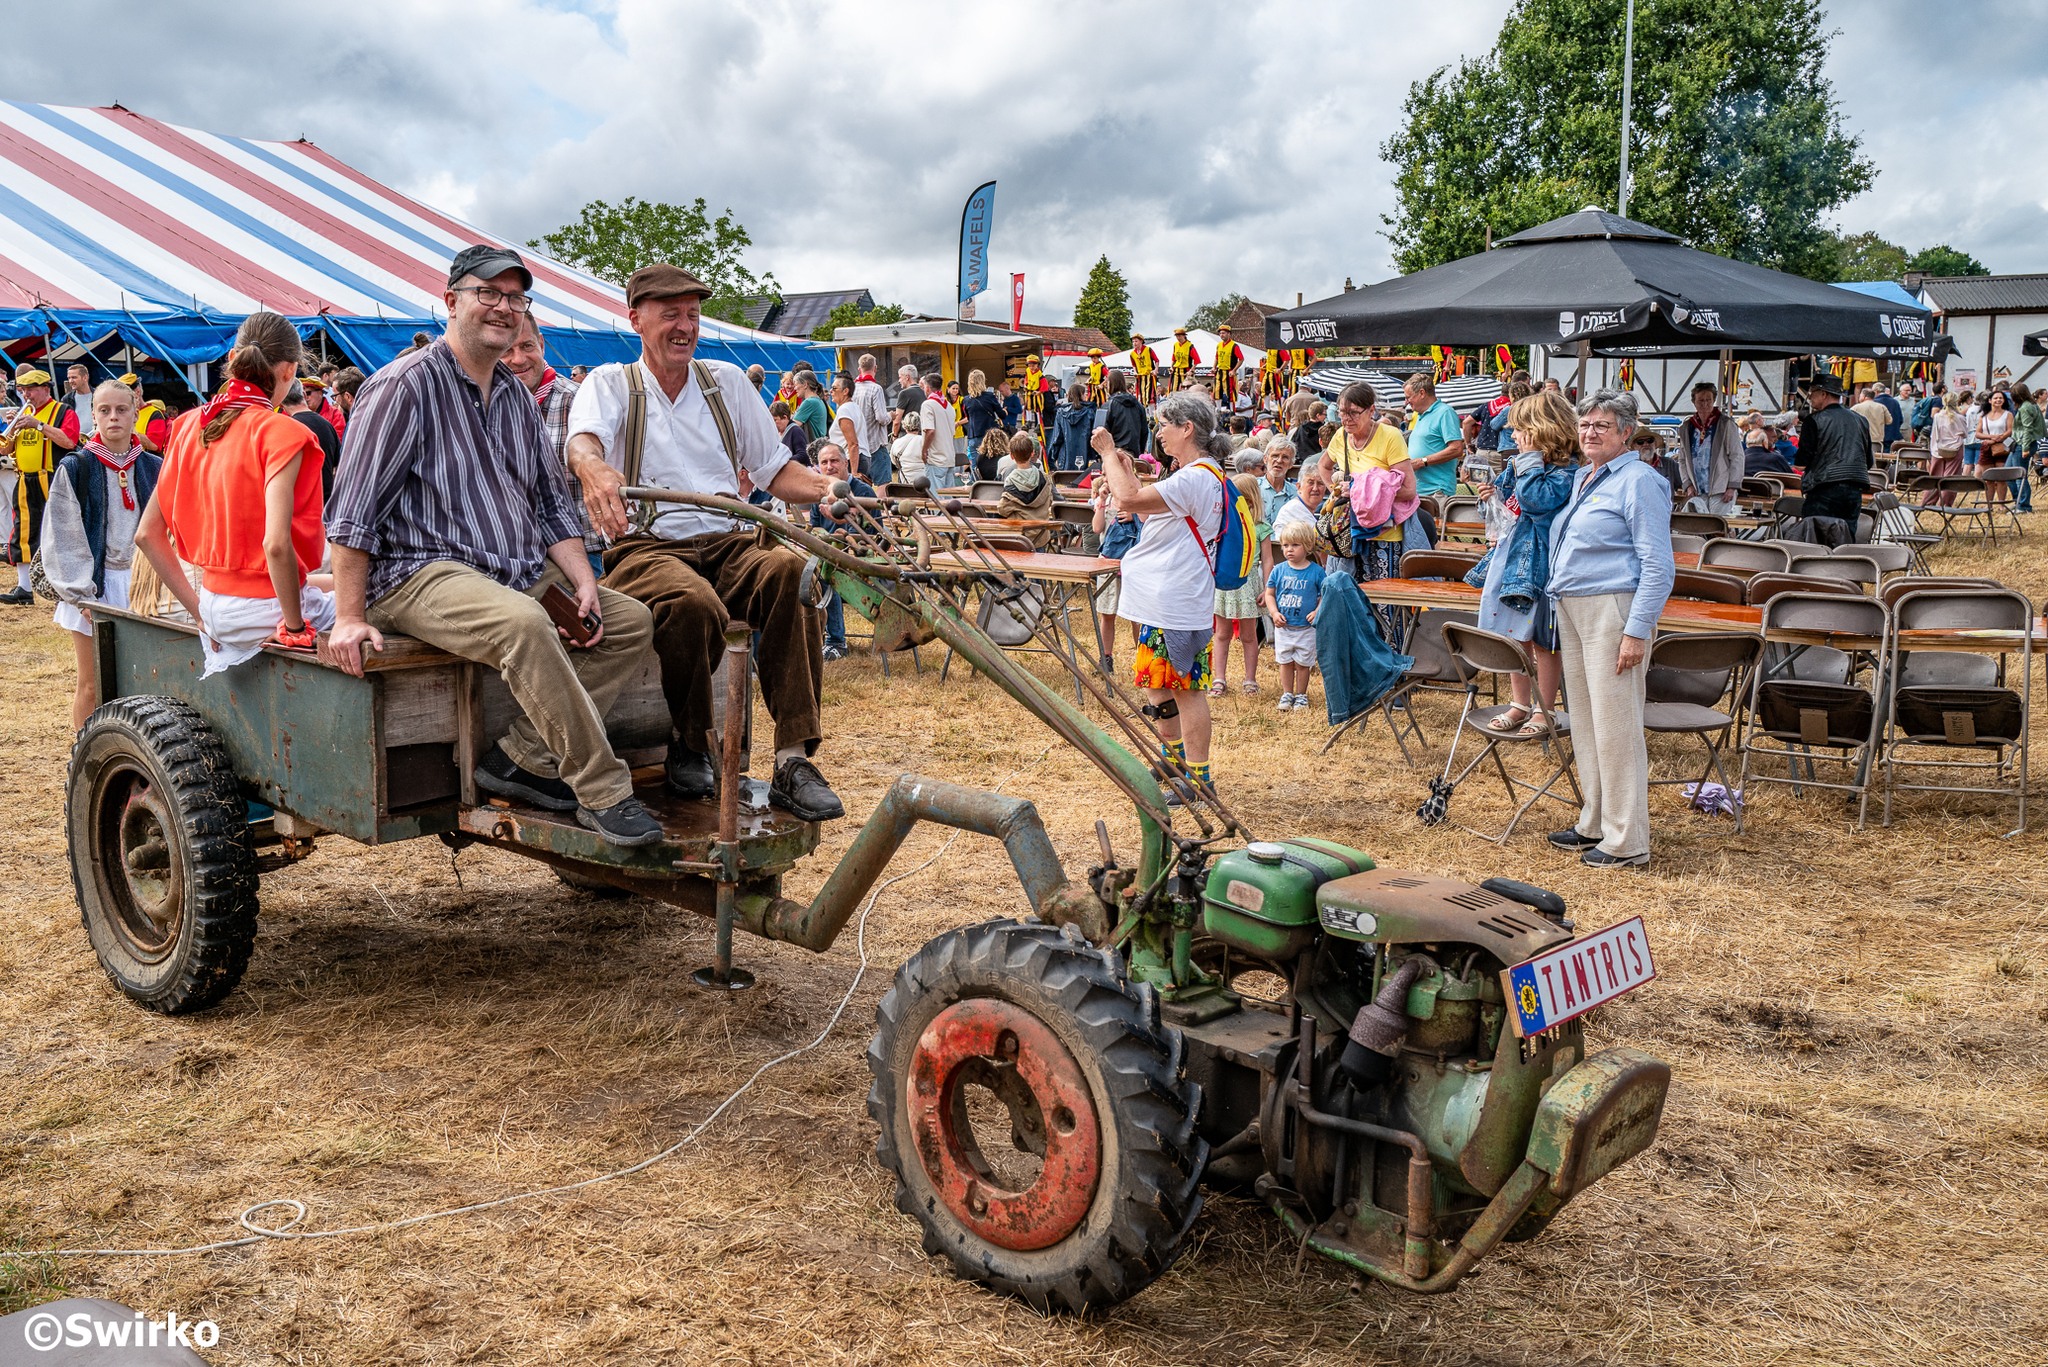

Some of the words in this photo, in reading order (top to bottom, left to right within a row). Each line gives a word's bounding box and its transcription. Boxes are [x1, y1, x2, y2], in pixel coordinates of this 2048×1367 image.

[968, 197, 985, 277] WAFELS
[1296, 321, 1338, 342] CORNET
[1892, 318, 1925, 339] CORNET
[1541, 930, 1643, 1015] TANTRIS
